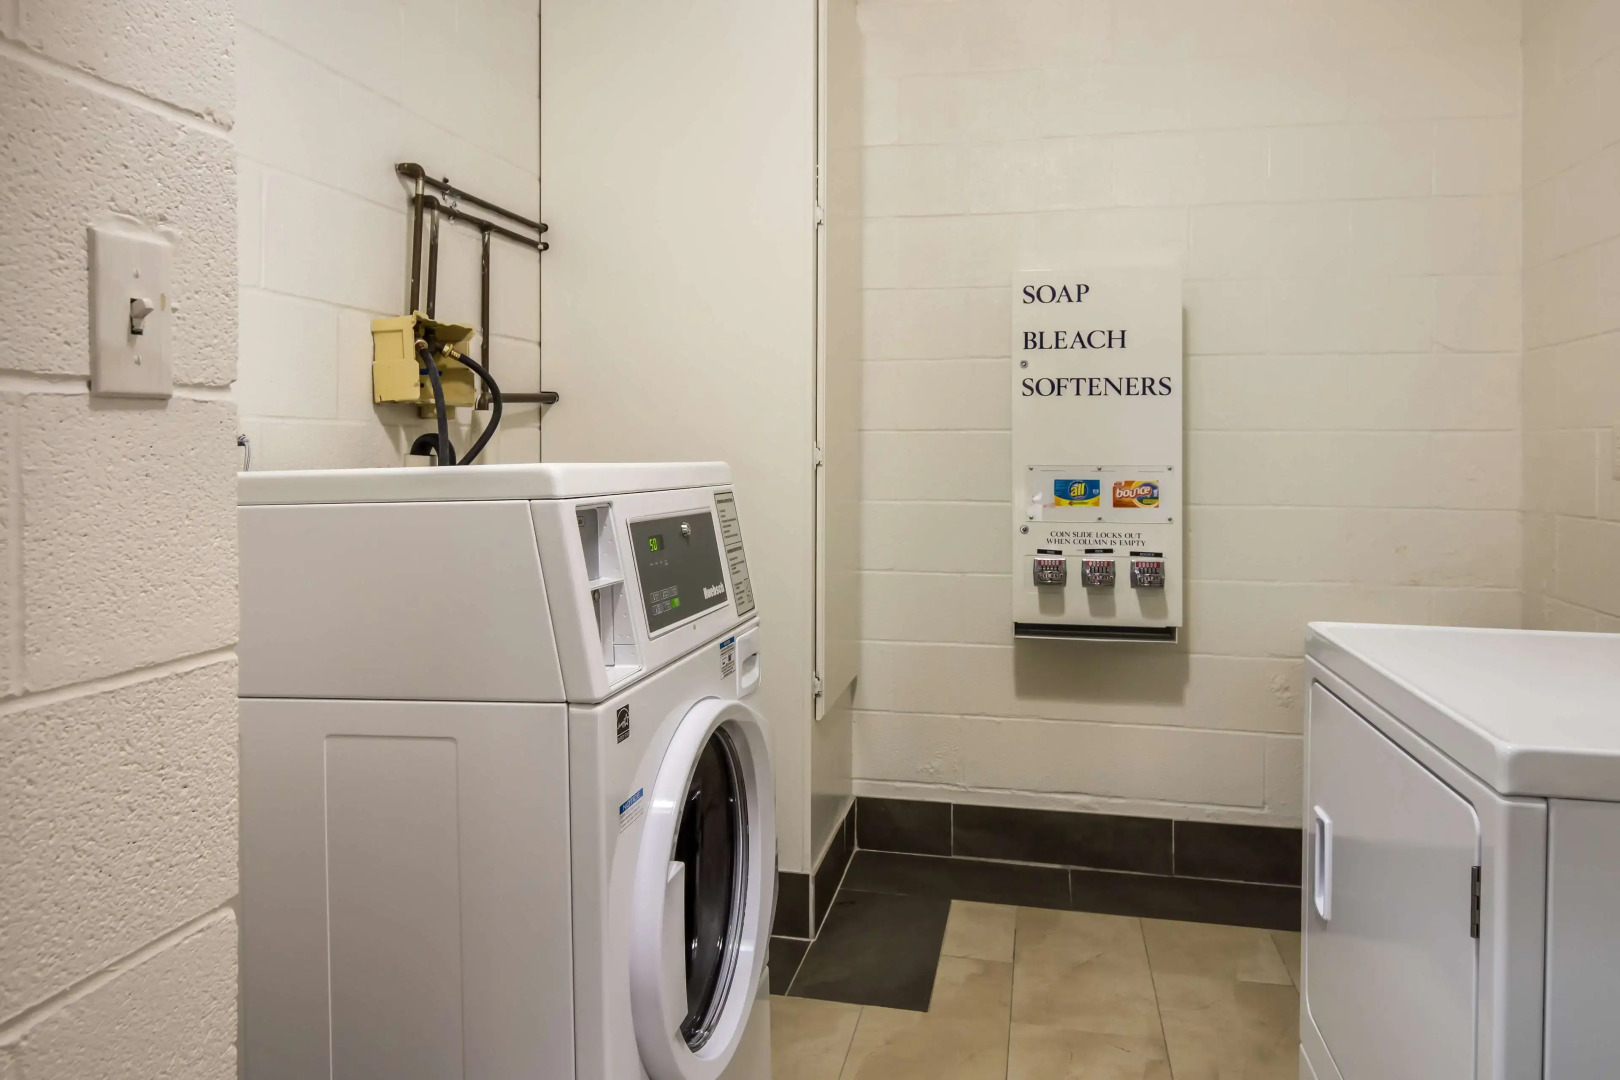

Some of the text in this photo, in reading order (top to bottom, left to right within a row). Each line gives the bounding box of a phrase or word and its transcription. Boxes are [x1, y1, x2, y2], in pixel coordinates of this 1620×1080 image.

[1022, 283, 1090, 304] SOAP
[1023, 329, 1127, 350] BLEACH
[1021, 376, 1172, 397] SOFTENERS
[1070, 482, 1085, 497] all
[1115, 485, 1152, 499] bounce
[1072, 531, 1094, 539] SLIDE
[1124, 532, 1142, 540] OUT
[1072, 538, 1110, 546] COLUMN
[1119, 539, 1146, 547] EMPTY
